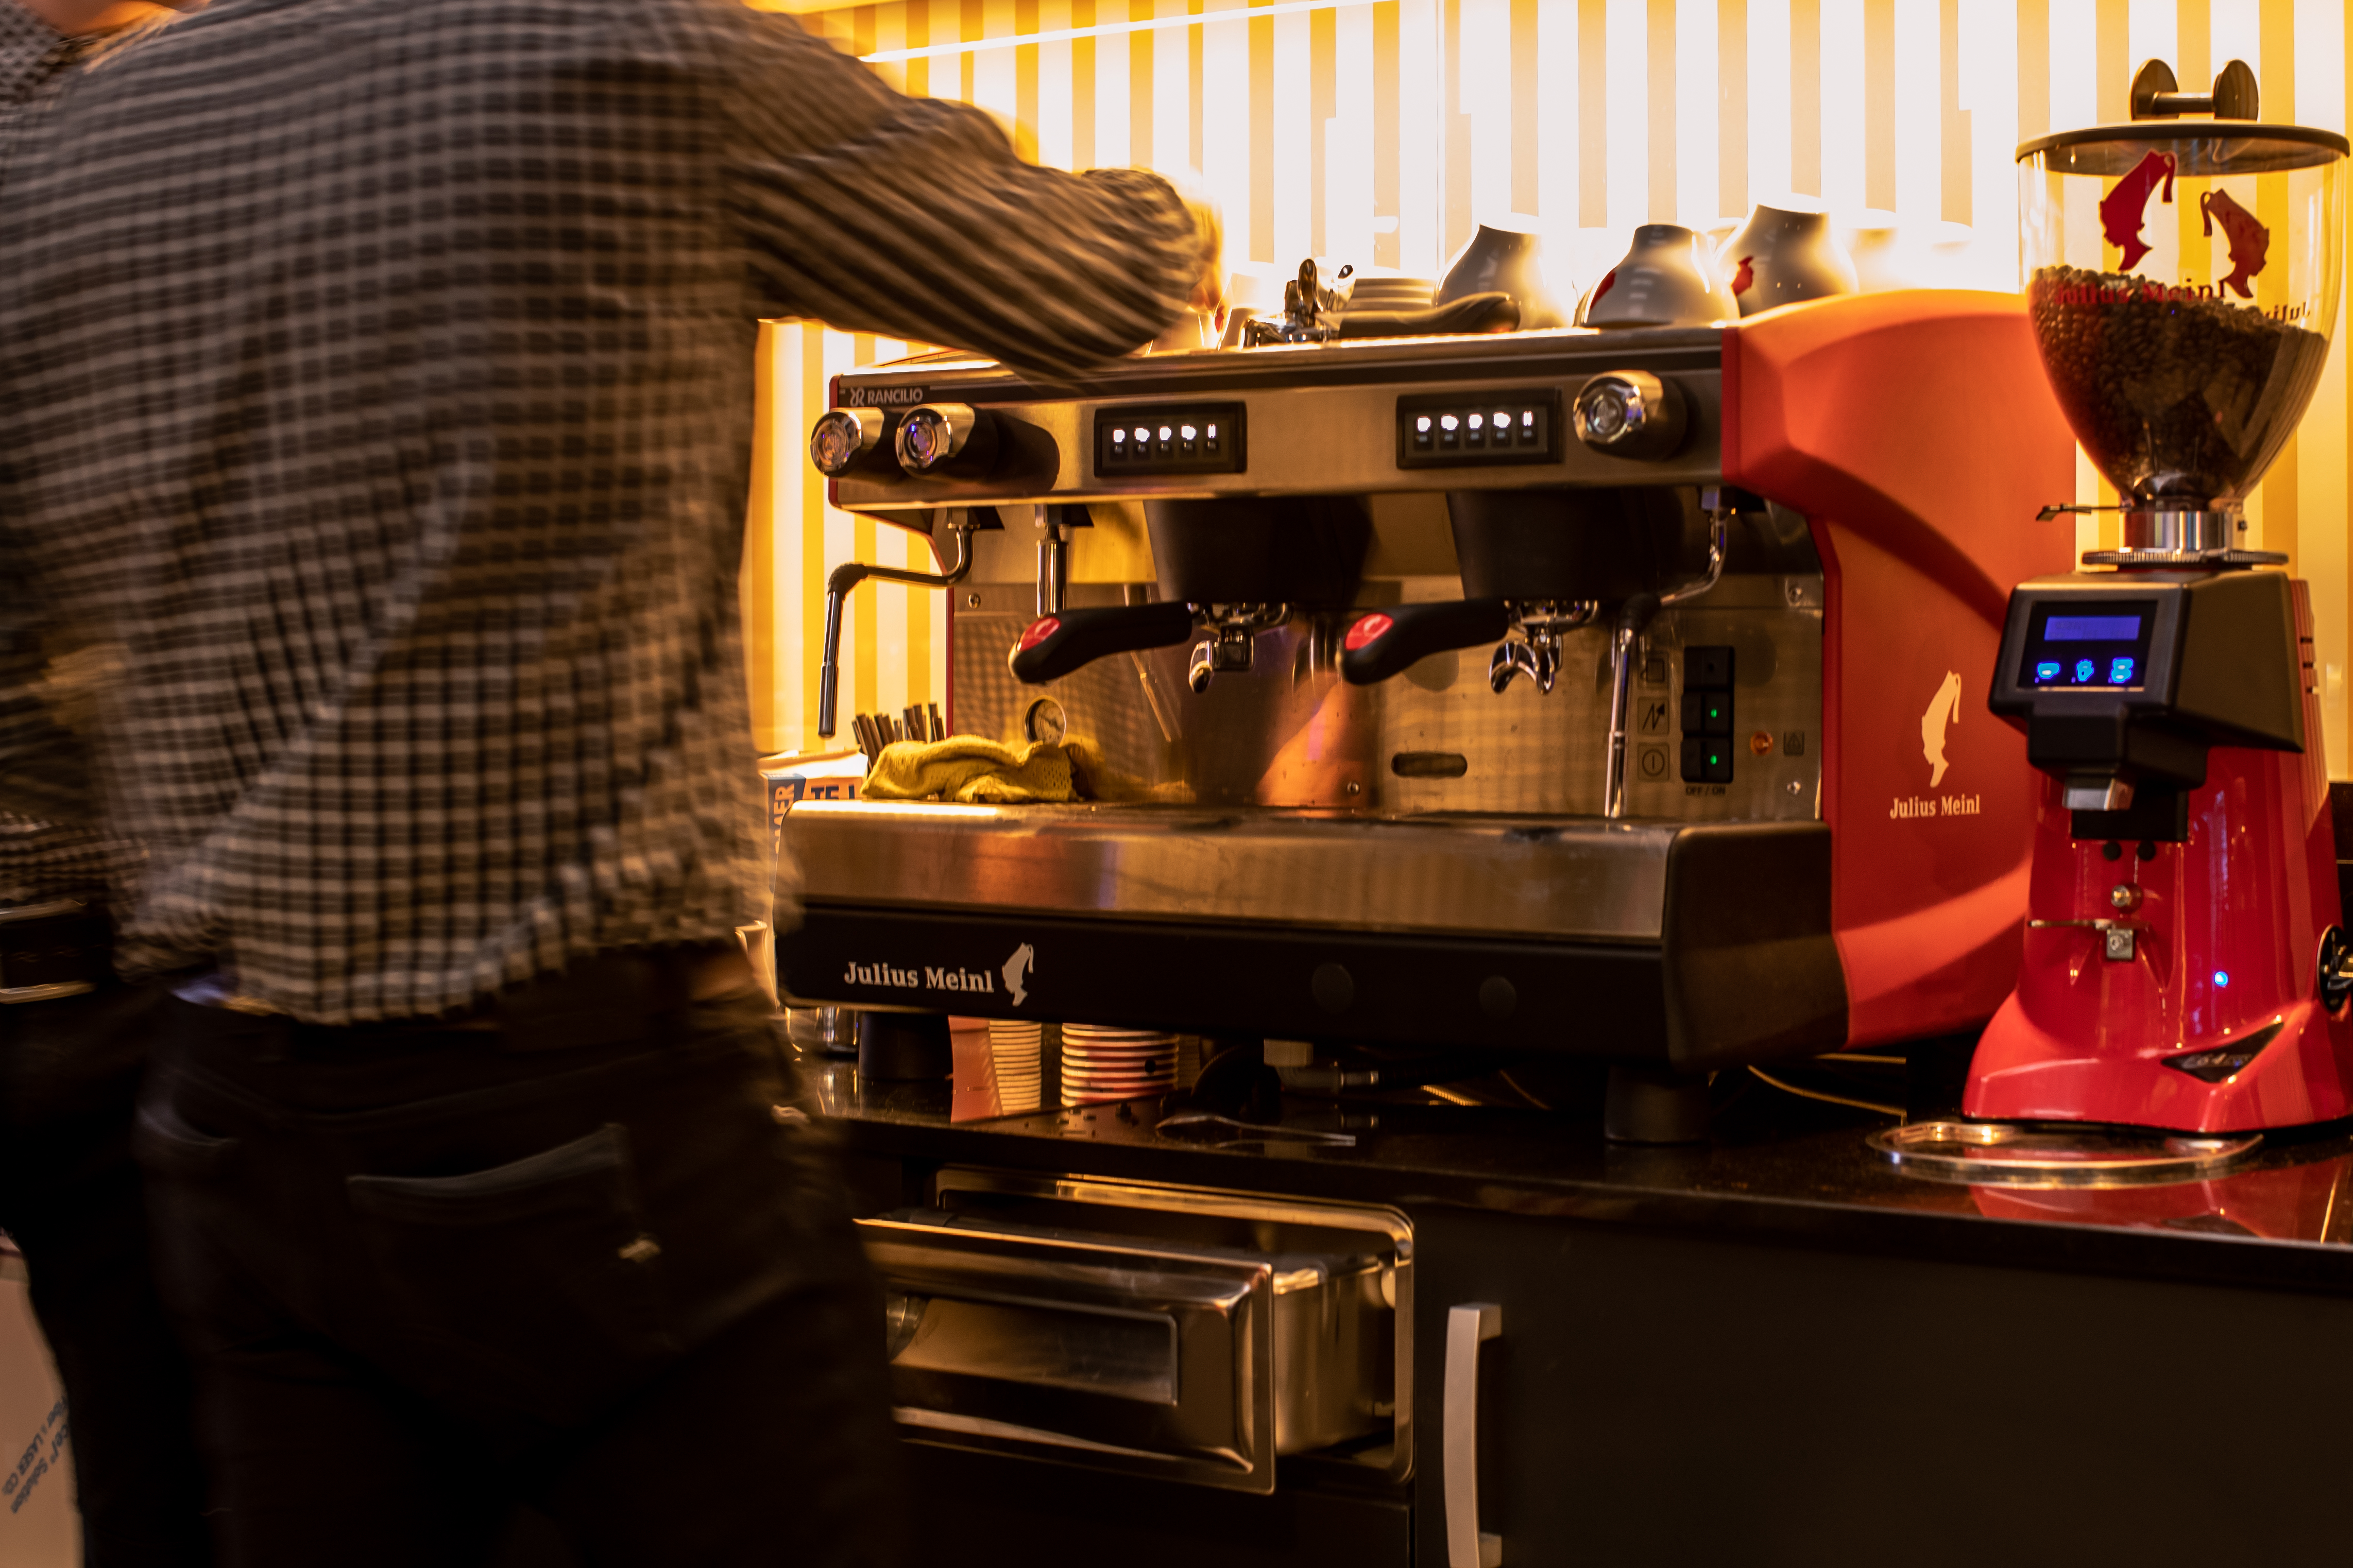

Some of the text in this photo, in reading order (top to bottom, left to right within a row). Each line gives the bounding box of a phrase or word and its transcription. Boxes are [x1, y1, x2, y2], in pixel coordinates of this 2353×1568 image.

[2054, 278, 2226, 305] Julius Meinl
[867, 387, 924, 405] RANCILIO
[1889, 792, 1981, 820] Julius Meinl
[844, 961, 995, 993] Julius Meinl
